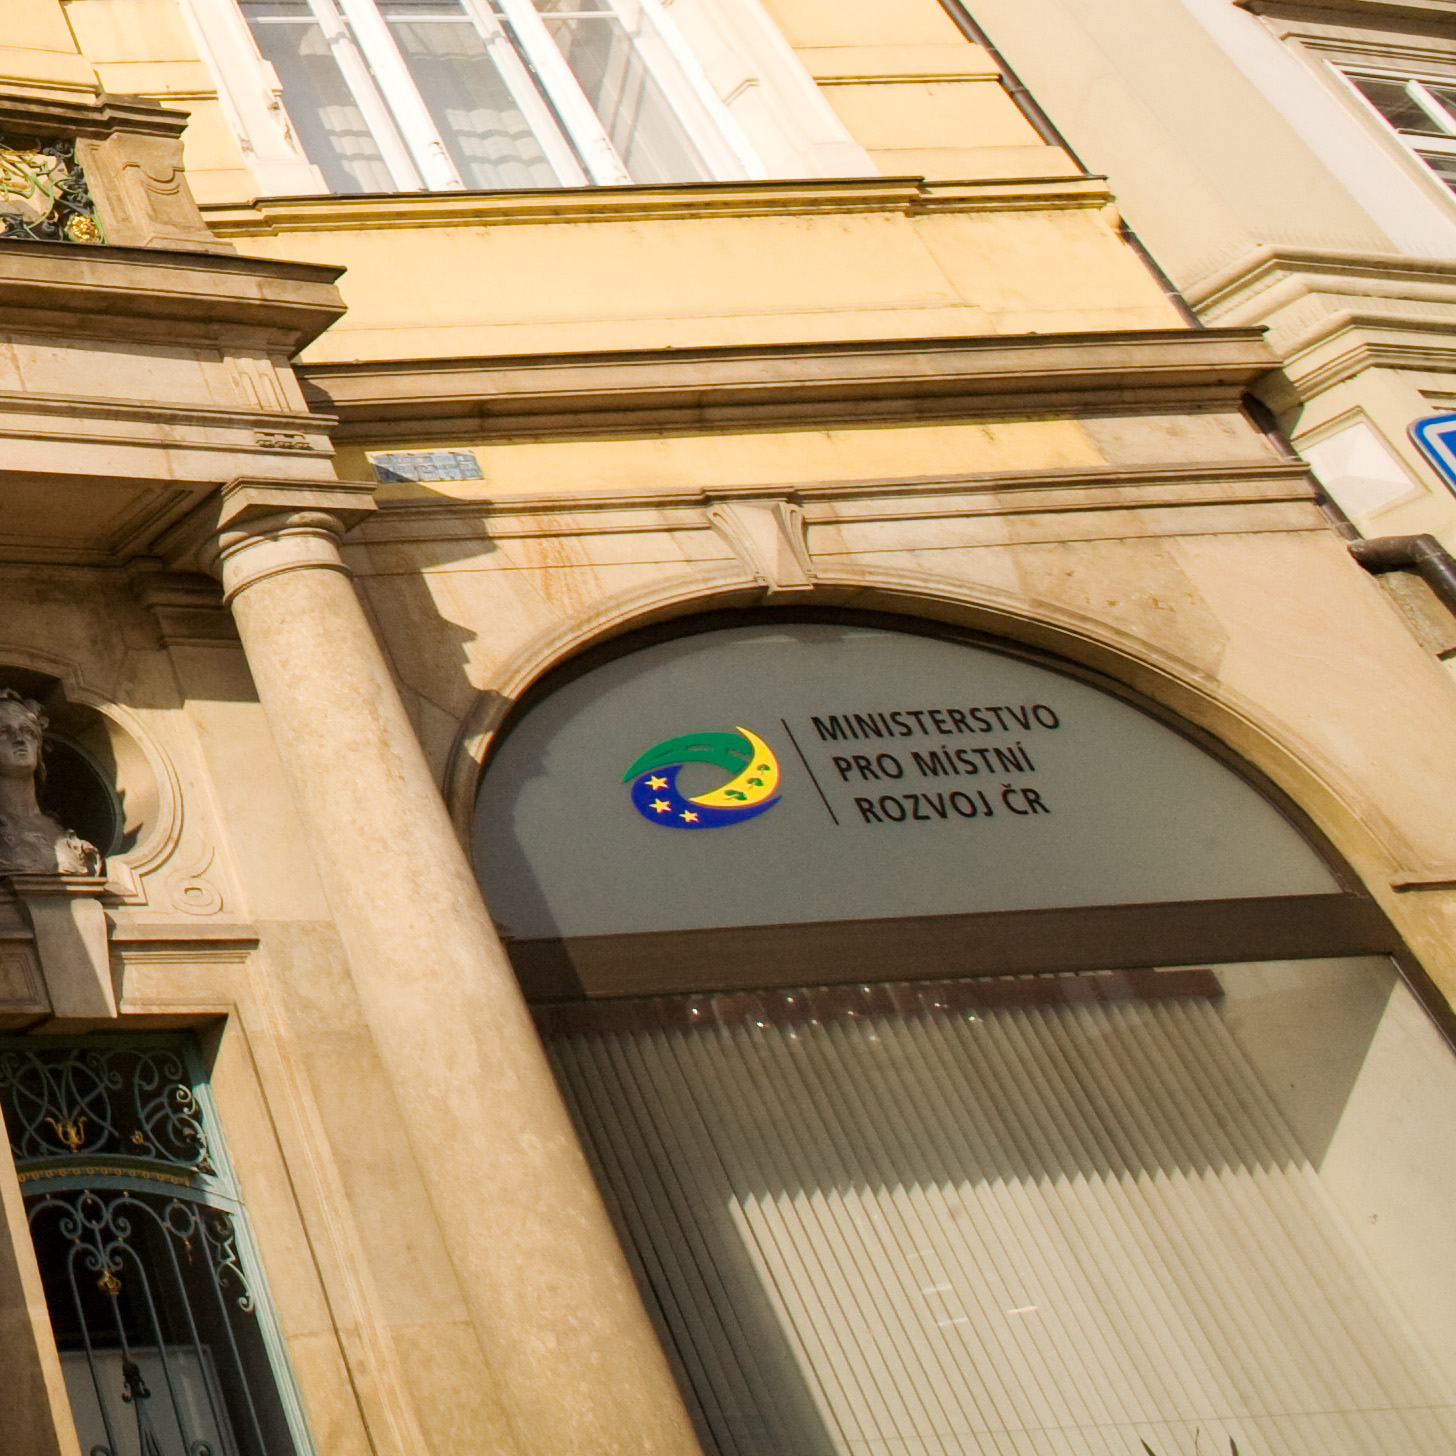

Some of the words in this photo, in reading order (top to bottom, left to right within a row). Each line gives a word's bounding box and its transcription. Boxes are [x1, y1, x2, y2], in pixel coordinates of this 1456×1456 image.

[810, 704, 1059, 741] MINISTERSTVO
[832, 753, 904, 781] PRO
[909, 741, 1036, 776] MÍSTNÍ
[853, 791, 994, 823] ROZVOJ
[1000, 783, 1052, 814] ČR
